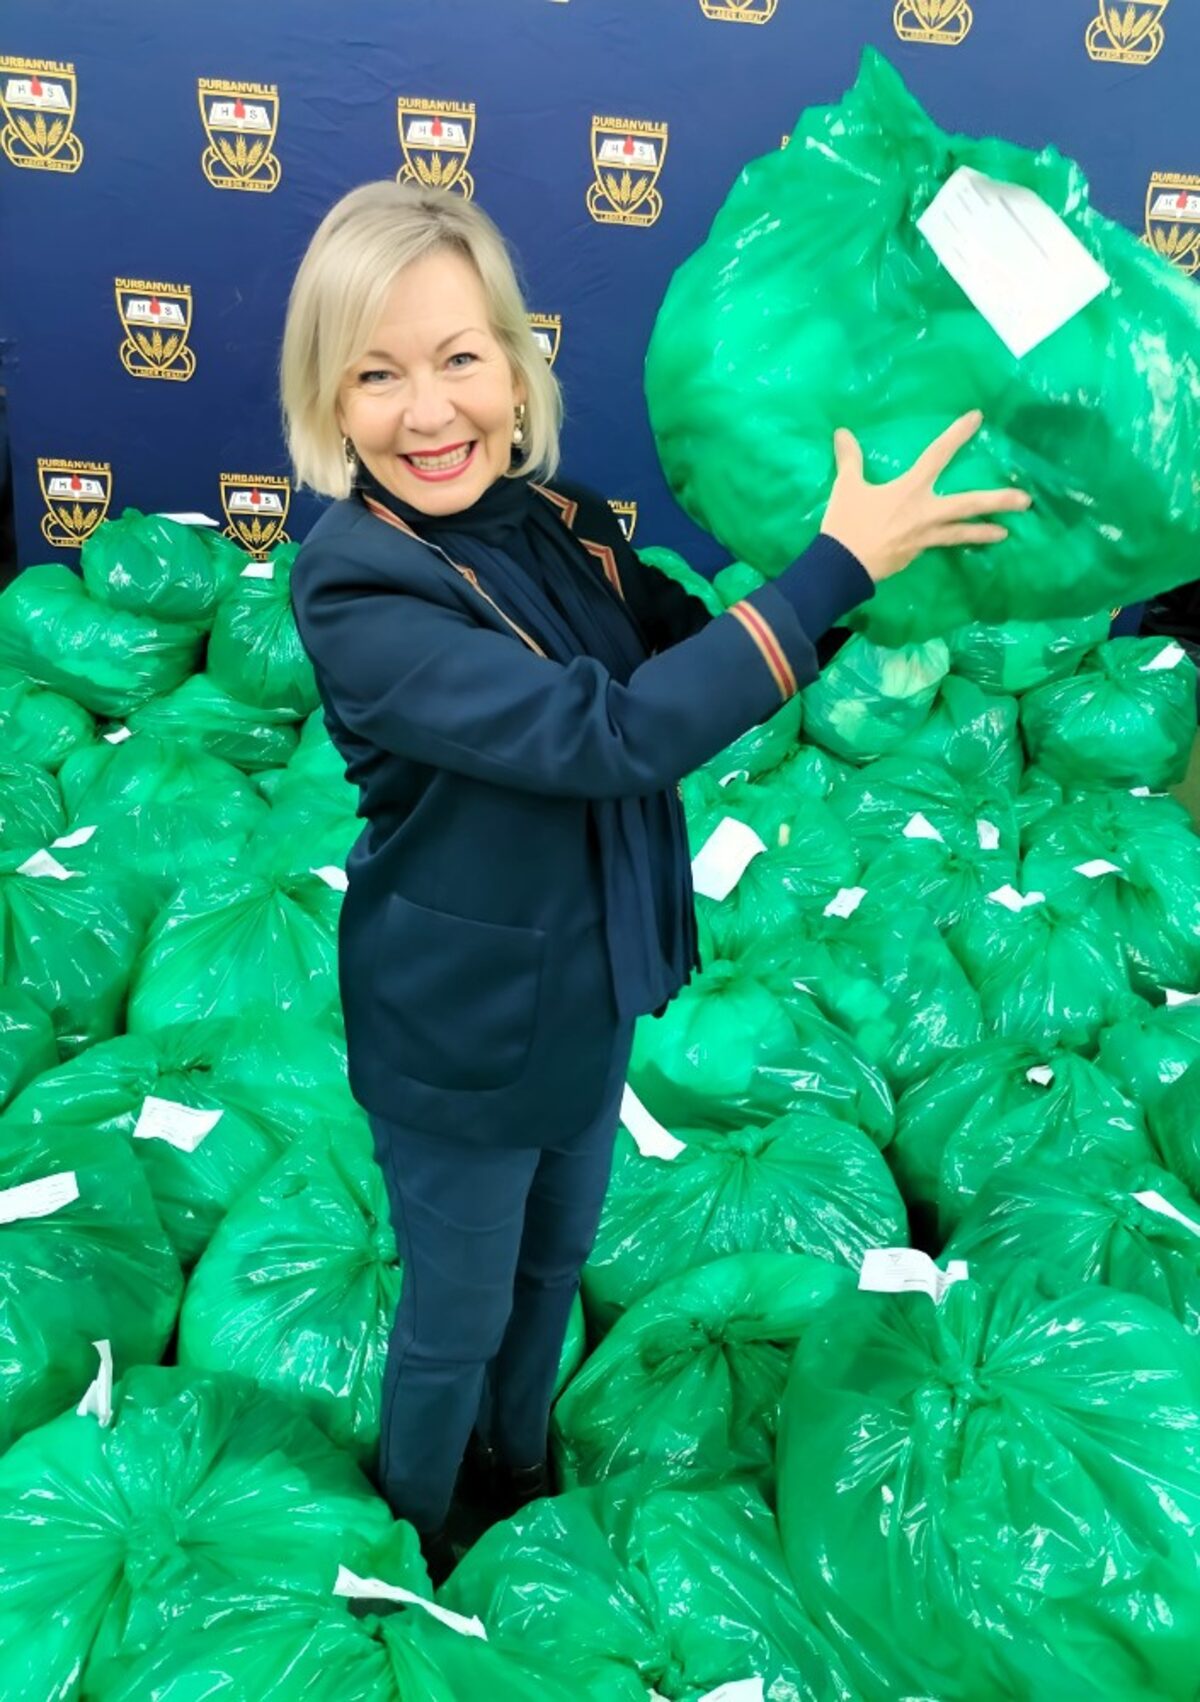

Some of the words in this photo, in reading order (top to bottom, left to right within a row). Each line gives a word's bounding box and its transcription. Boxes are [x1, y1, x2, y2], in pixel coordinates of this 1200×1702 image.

[0, 56, 75, 73] URBANVILLE
[198, 78, 278, 96] DURBANVILLE
[397, 97, 476, 113] DURBANVILLE
[592, 115, 668, 133] DURBANVILLE
[115, 278, 191, 295] DURBANVILLE
[38, 457, 110, 471] DURBANVILLE
[220, 472, 290, 486] DURBANVILLE
